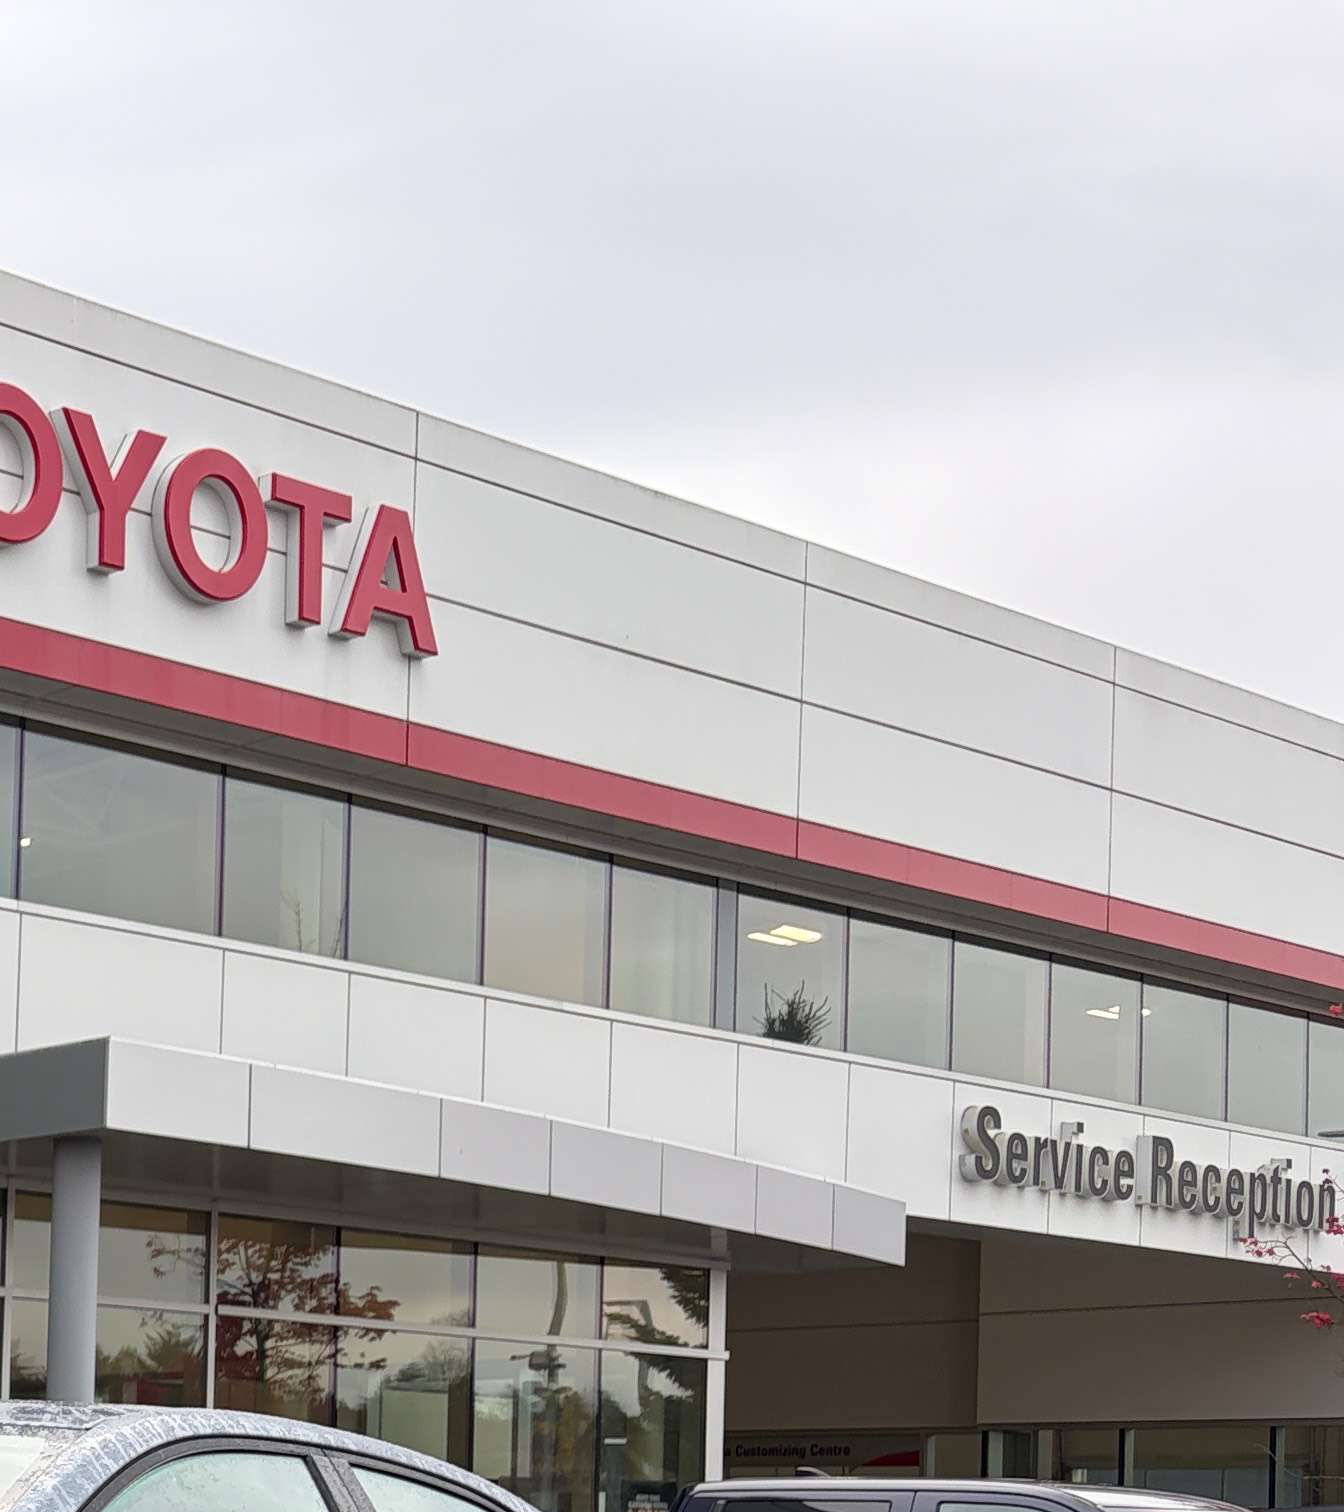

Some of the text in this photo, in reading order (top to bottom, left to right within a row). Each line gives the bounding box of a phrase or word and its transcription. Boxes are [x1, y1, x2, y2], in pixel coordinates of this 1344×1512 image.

[960, 1104, 1336, 1239] Service Reception
[735, 1444, 807, 1459] Customizing
